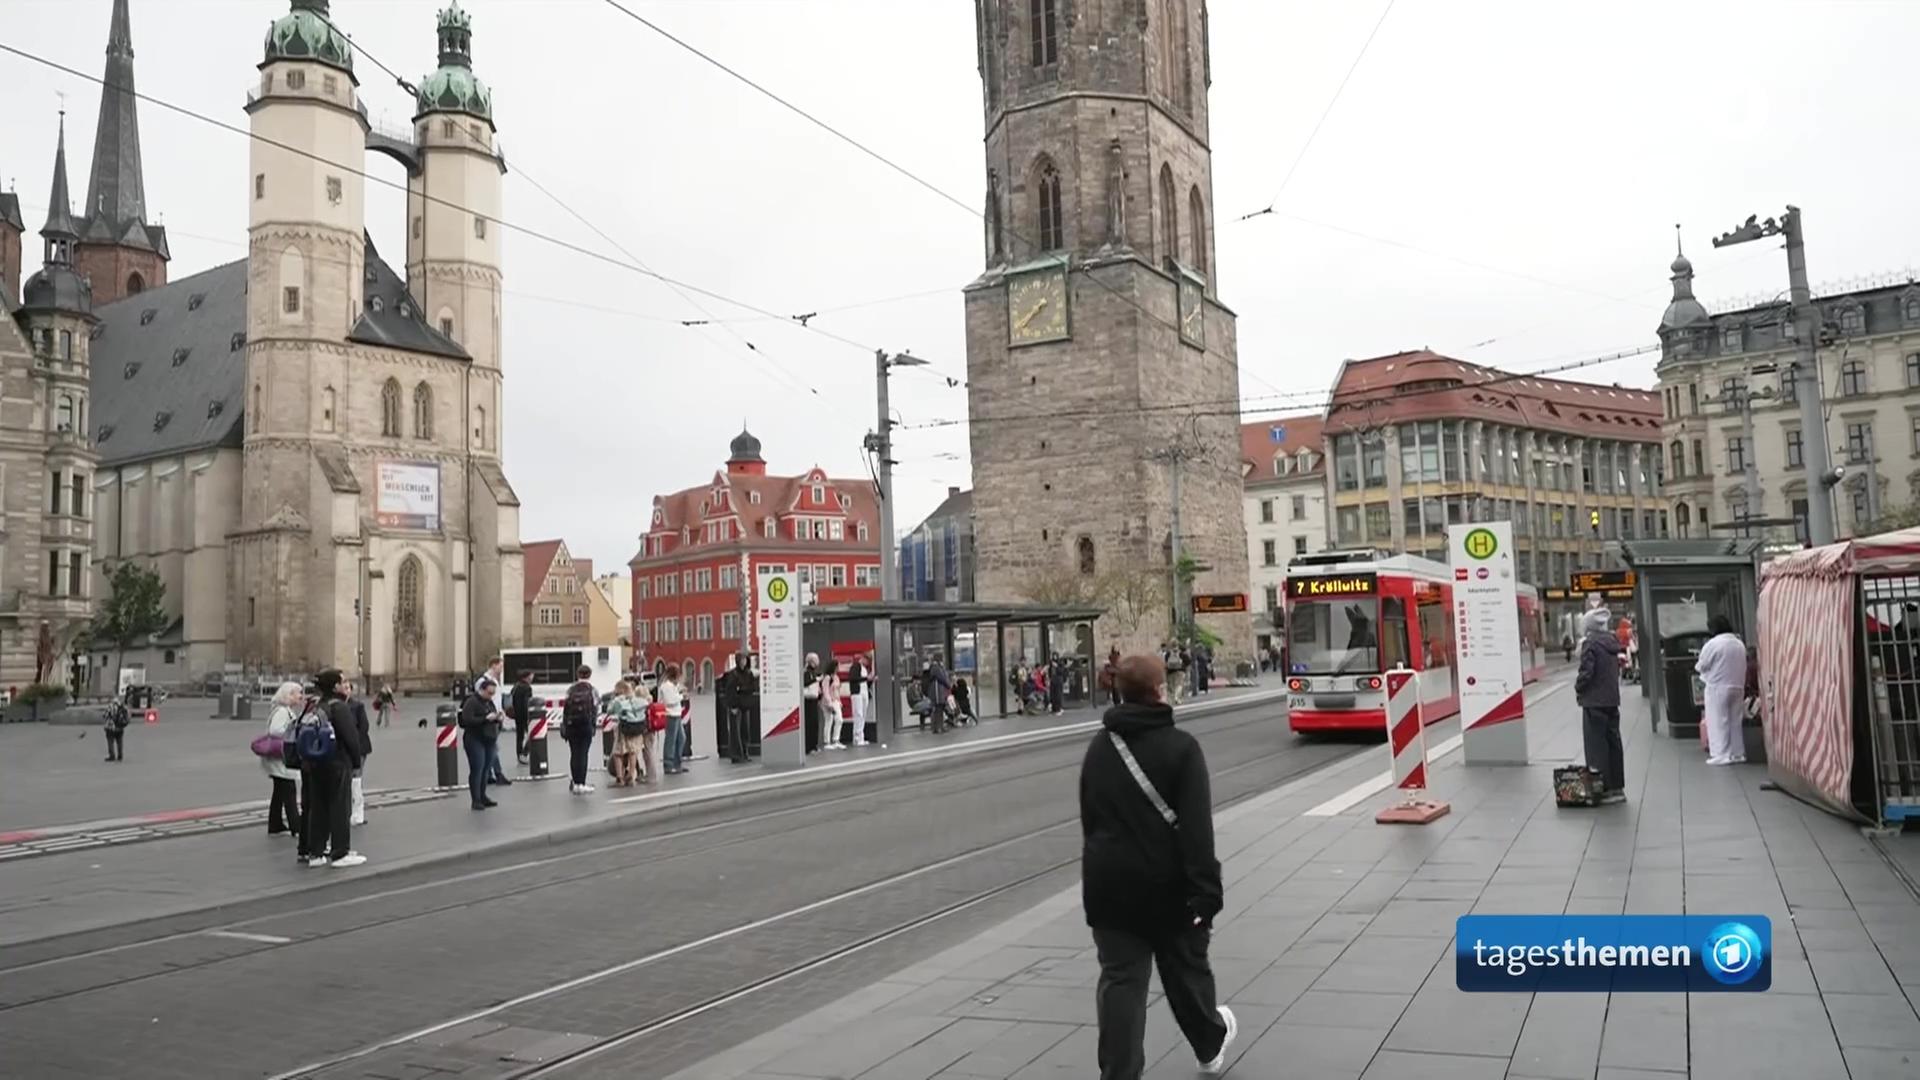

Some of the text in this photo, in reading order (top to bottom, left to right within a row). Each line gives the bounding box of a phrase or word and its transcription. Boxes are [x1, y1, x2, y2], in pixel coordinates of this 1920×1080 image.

[1473, 535, 1488, 554] H
[773, 583, 783, 597] H
[1297, 581, 1305, 594] 7
